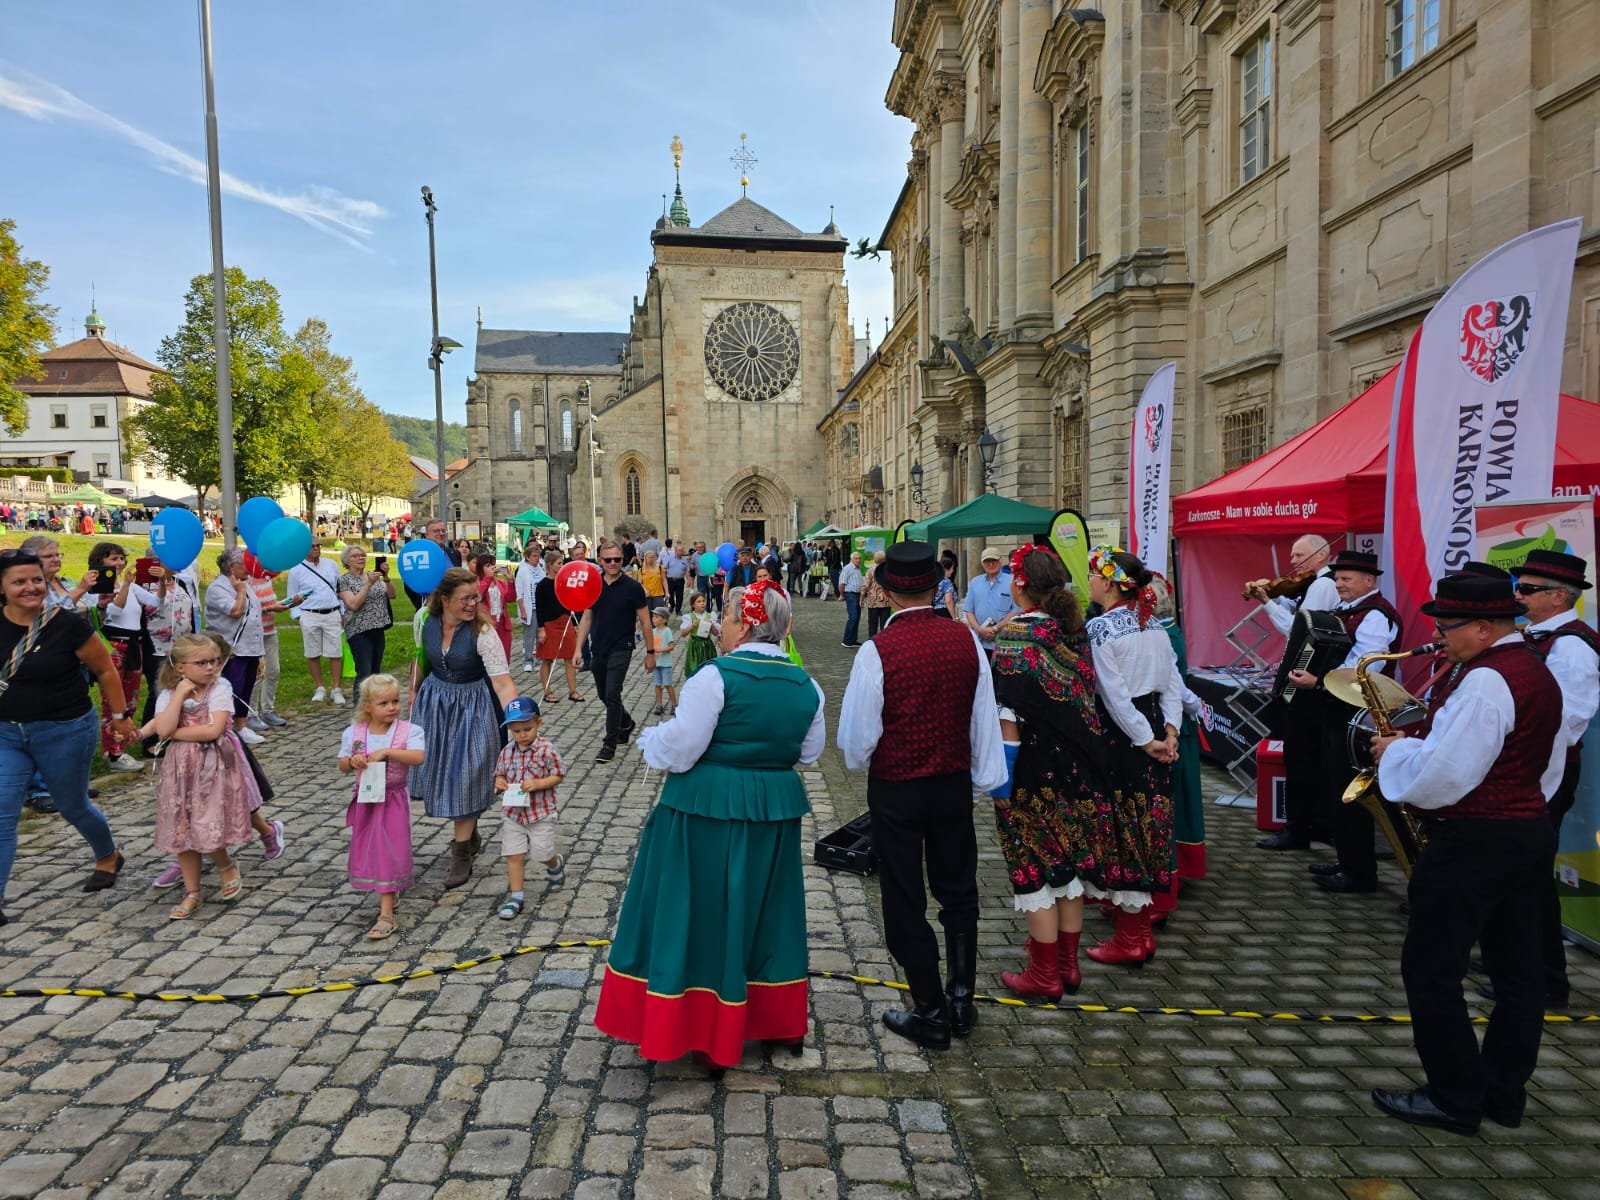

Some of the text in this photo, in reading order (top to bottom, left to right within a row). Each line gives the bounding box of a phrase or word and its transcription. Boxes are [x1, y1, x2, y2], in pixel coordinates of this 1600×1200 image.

[1485, 399, 1519, 502] POWIA
[1554, 485, 1582, 497] am
[1226, 505, 1243, 519] Mam
[1244, 506, 1251, 517] w
[1252, 502, 1273, 517] sobie
[1275, 500, 1300, 516] ducha
[1302, 499, 1318, 519] gór
